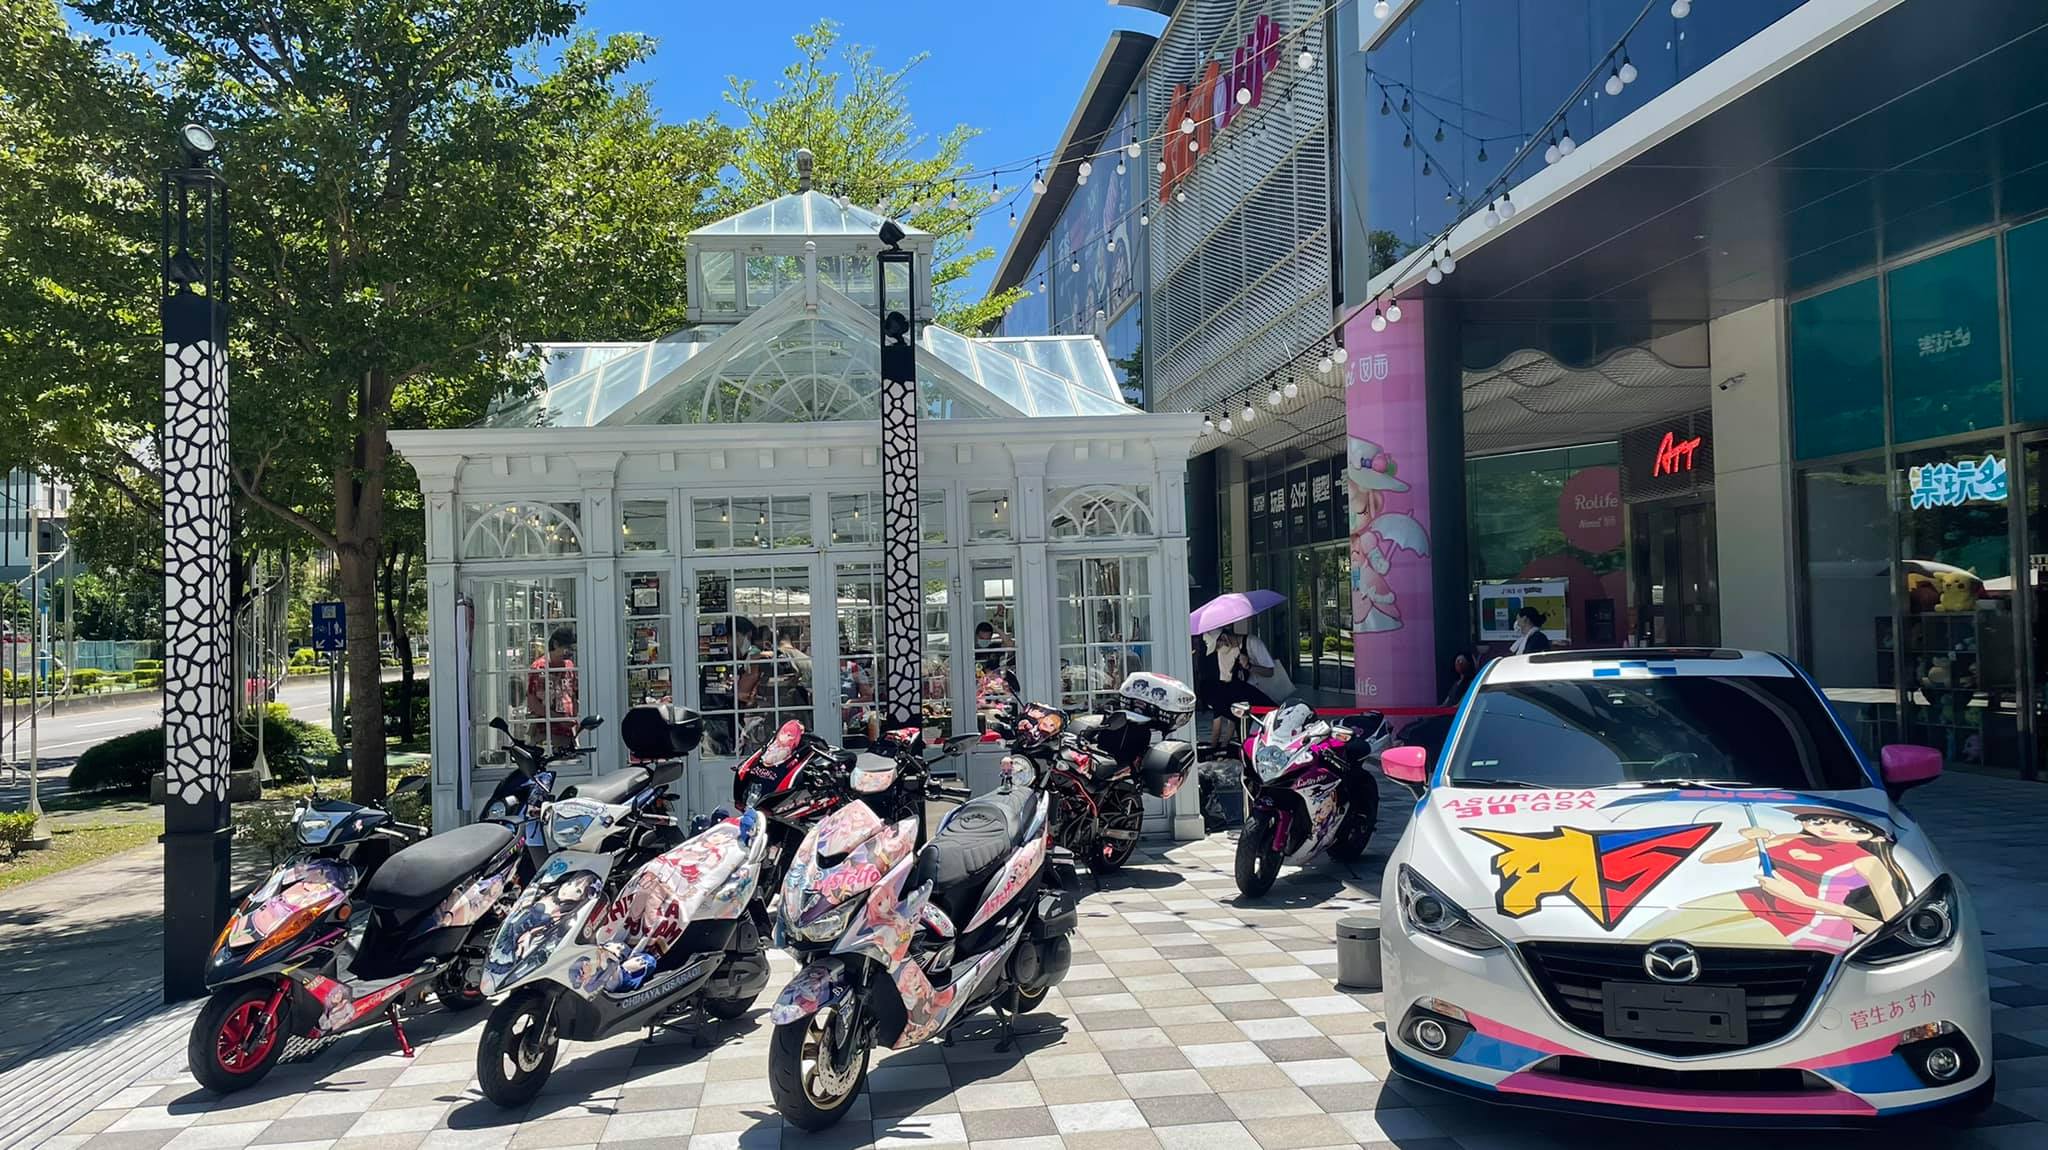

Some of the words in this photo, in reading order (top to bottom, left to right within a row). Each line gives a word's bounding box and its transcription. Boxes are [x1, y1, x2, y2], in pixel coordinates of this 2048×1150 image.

[1441, 791, 1596, 809] ASURADA
[1849, 988, 1936, 1030] 菅生あすか
